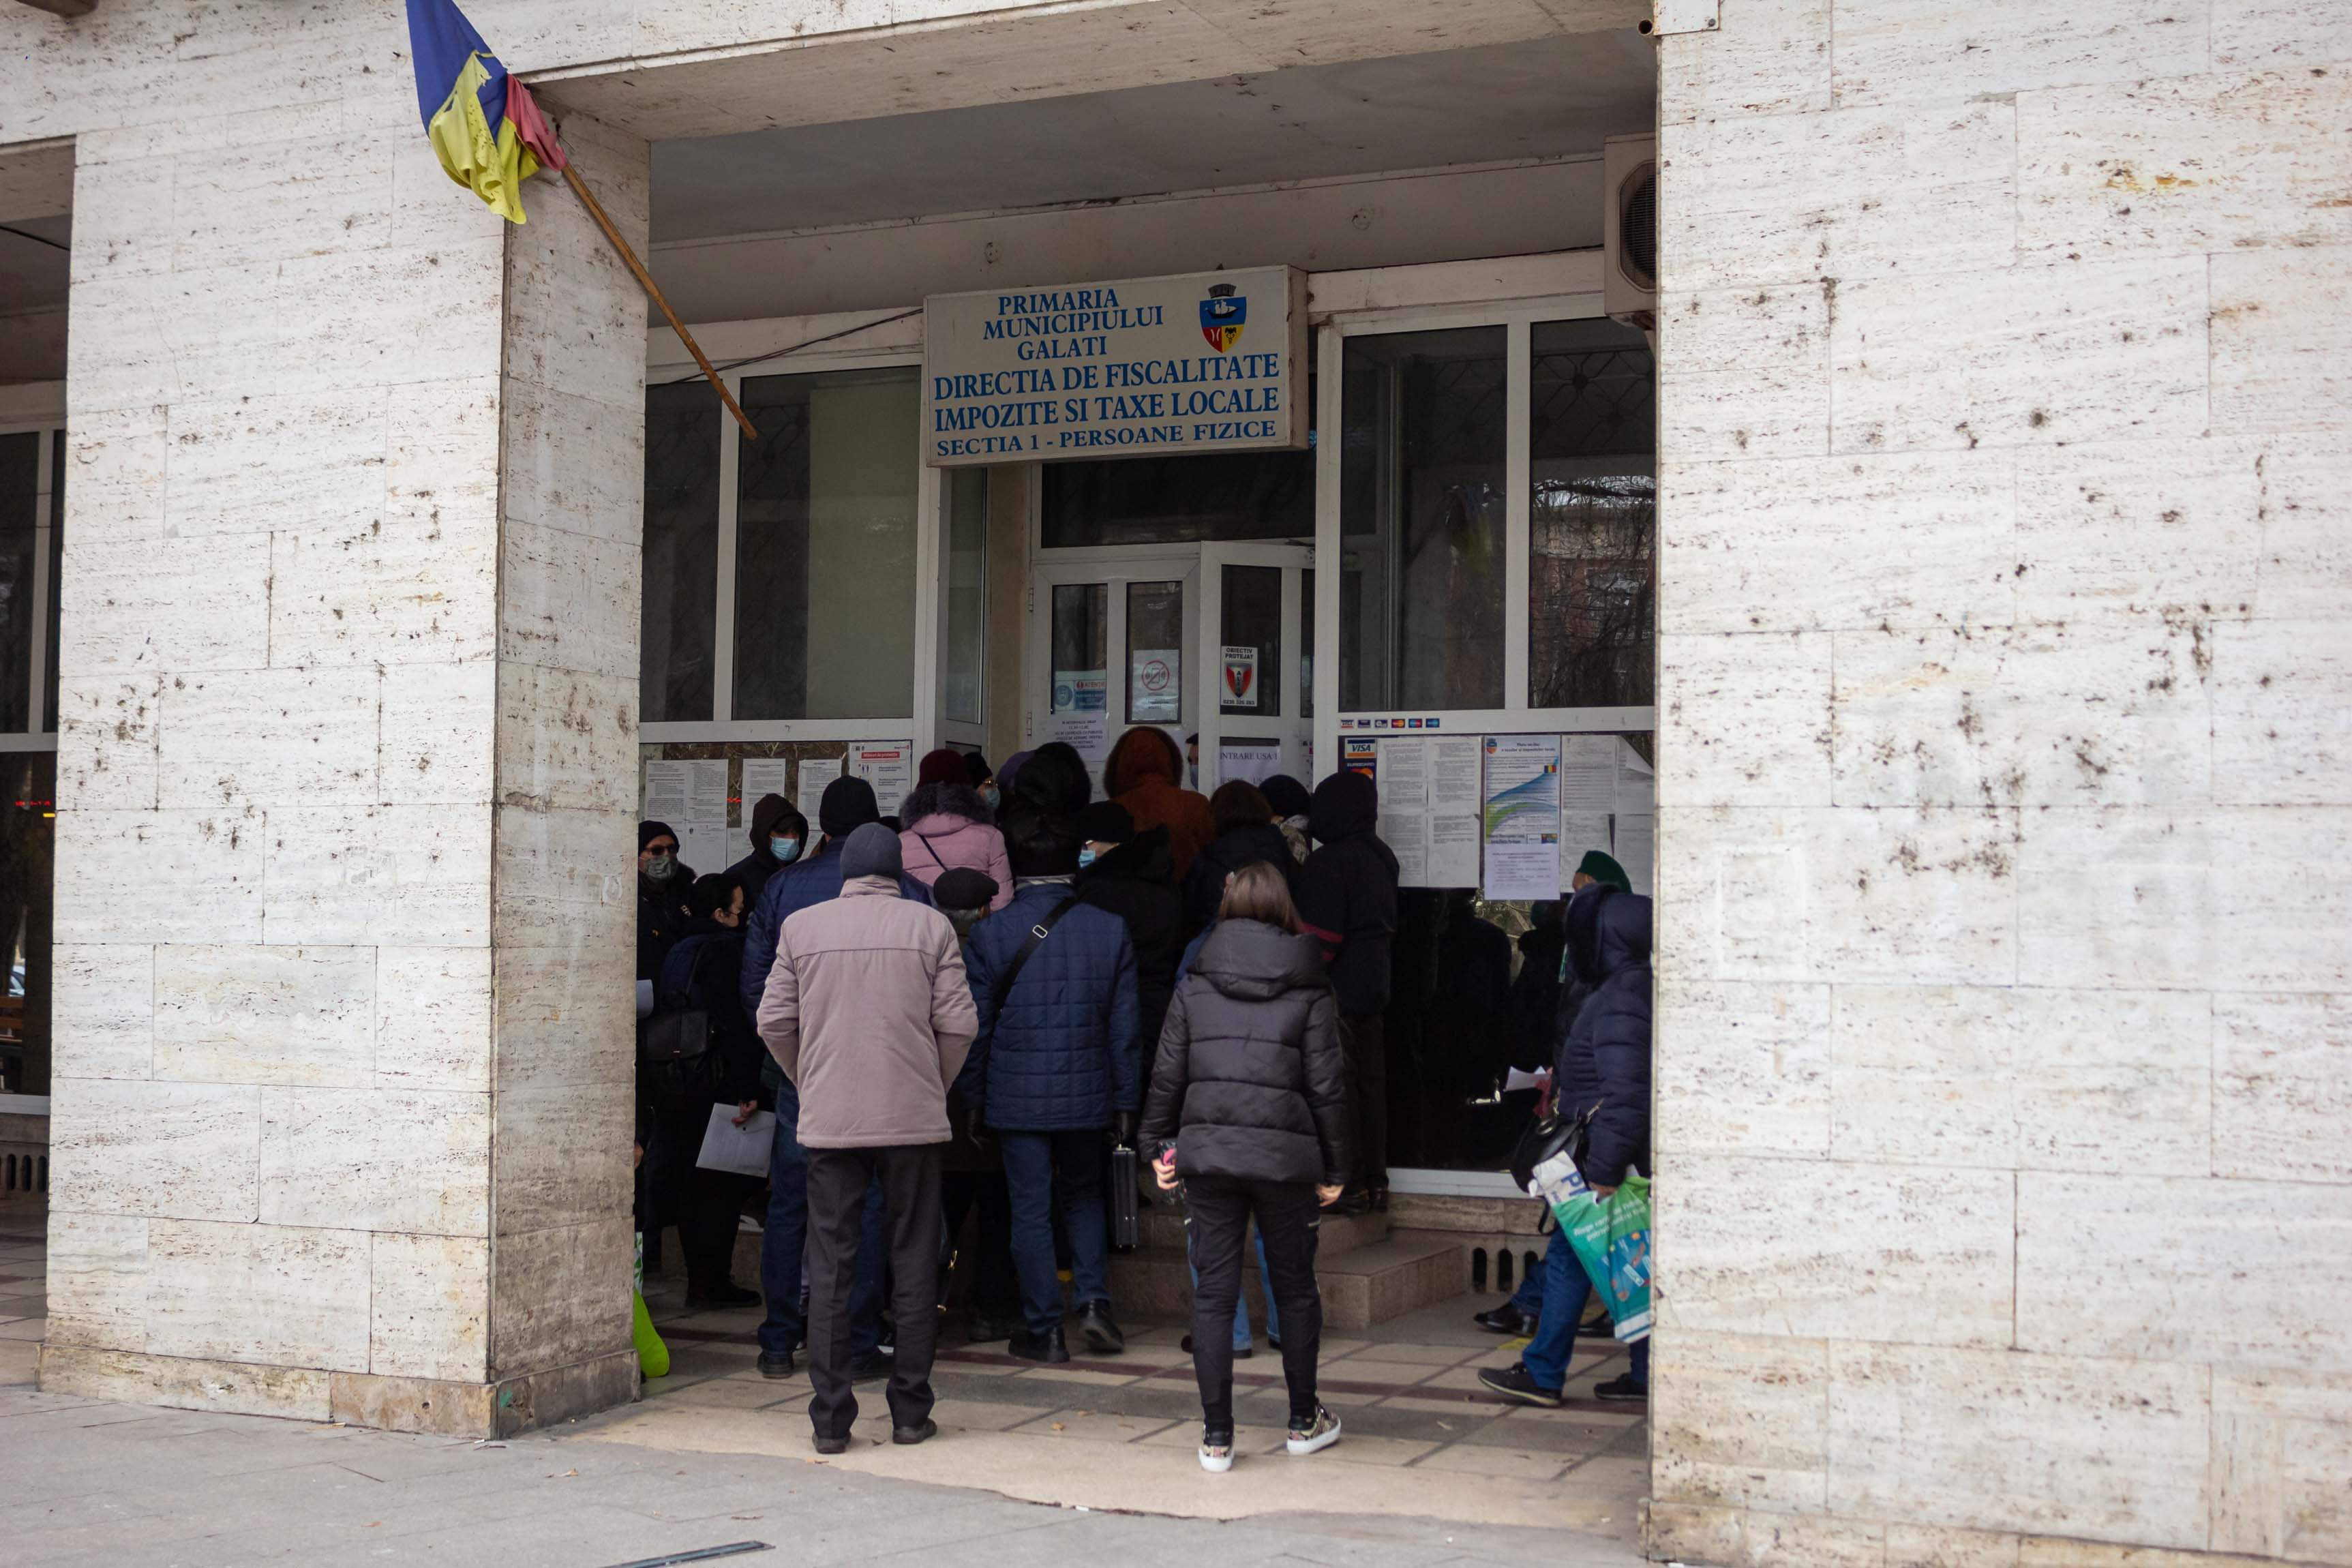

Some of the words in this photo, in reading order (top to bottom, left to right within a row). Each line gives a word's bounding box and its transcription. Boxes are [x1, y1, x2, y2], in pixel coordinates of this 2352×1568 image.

[999, 288, 1118, 316] PRIMARIA
[984, 305, 1163, 339] MUNICIPIULUI
[1017, 335, 1107, 361] GALATI
[935, 369, 1055, 401] DIRECTIA
[1063, 365, 1099, 391] DE
[1106, 353, 1280, 389] FISCALITATE
[935, 401, 1058, 432] IMPOZITE
[1065, 397, 1087, 423] SI
[1094, 393, 1164, 420] TAXE
[1172, 387, 1279, 417] LOCALE
[937, 436, 1023, 456] SECTIA
[1030, 436, 1039, 451] 1
[1060, 425, 1183, 448] PERSOANE
[1194, 420, 1276, 440] FIZICE
[1352, 744, 1372, 752] VISA
